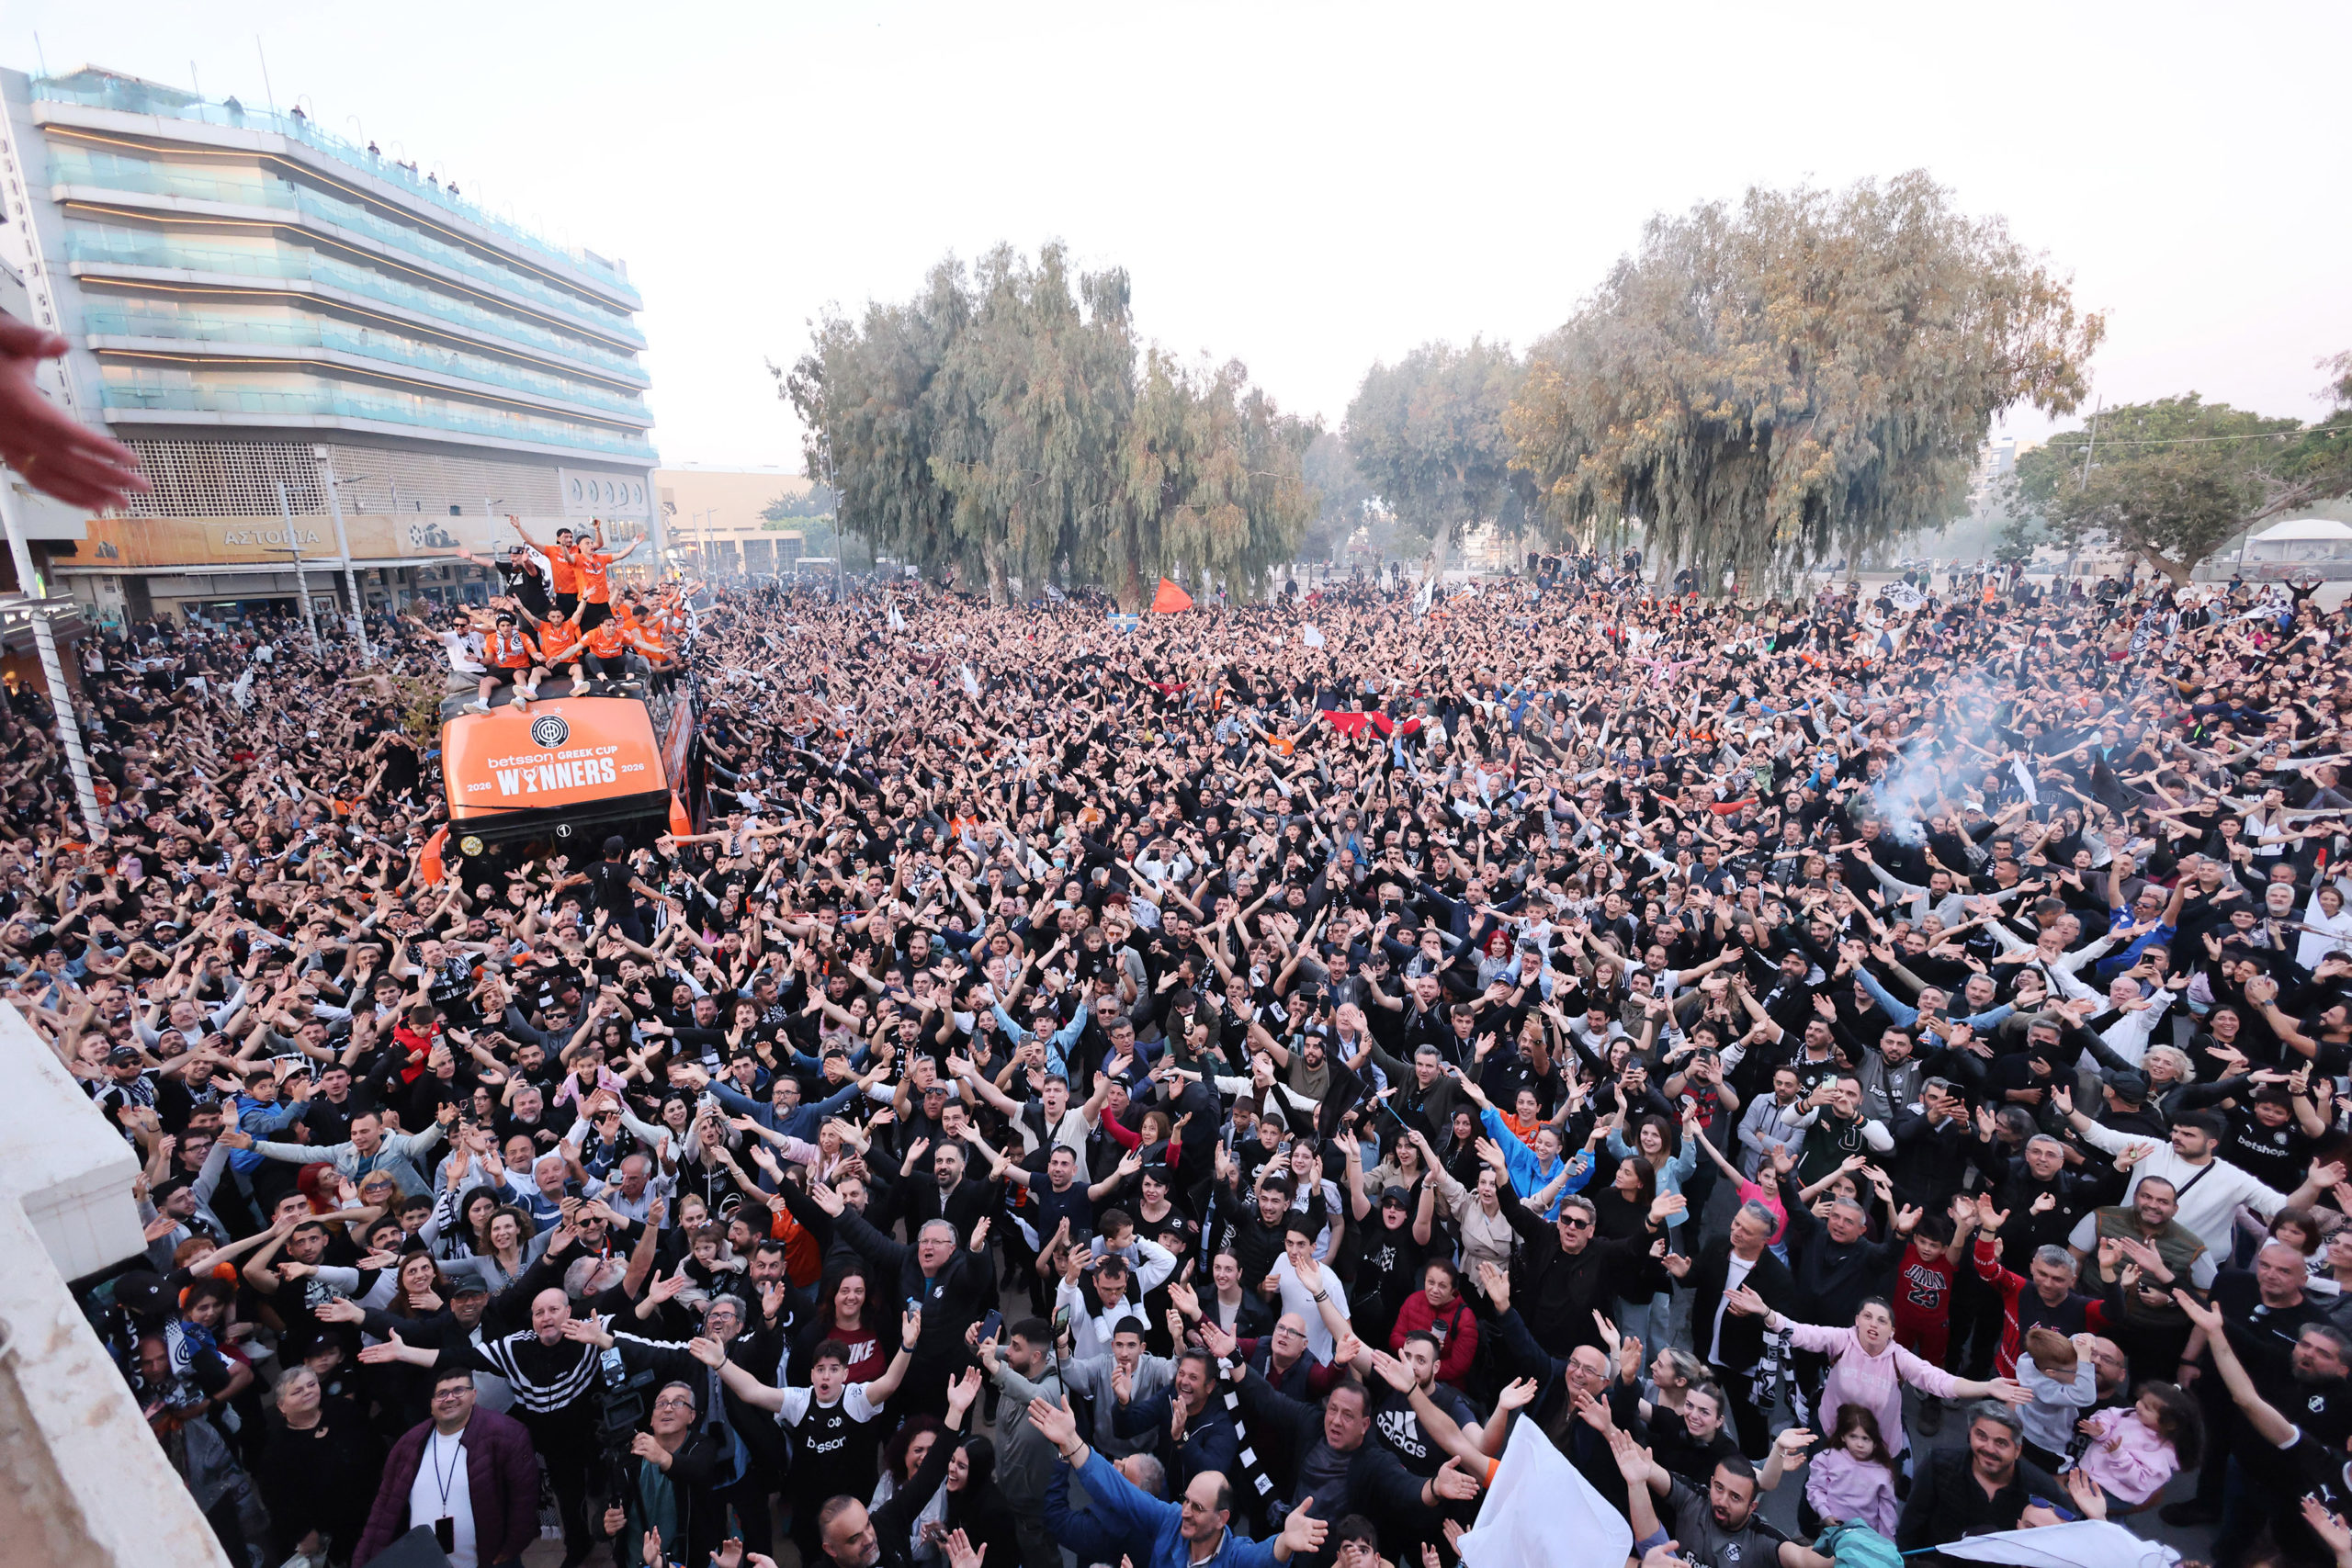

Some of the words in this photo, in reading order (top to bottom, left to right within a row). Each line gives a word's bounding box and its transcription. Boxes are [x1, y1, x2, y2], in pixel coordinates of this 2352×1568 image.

[487, 752, 554, 769] betsson
[557, 748, 594, 761] GREEK
[595, 745, 618, 756] CUP
[467, 782, 492, 793] 2026
[620, 763, 645, 773] 2026
[1905, 1264, 1947, 1290] JORDAN
[1907, 1282, 1939, 1309] 23
[807, 1436, 846, 1453] bsson
[1376, 1413, 1427, 1459] adidas
